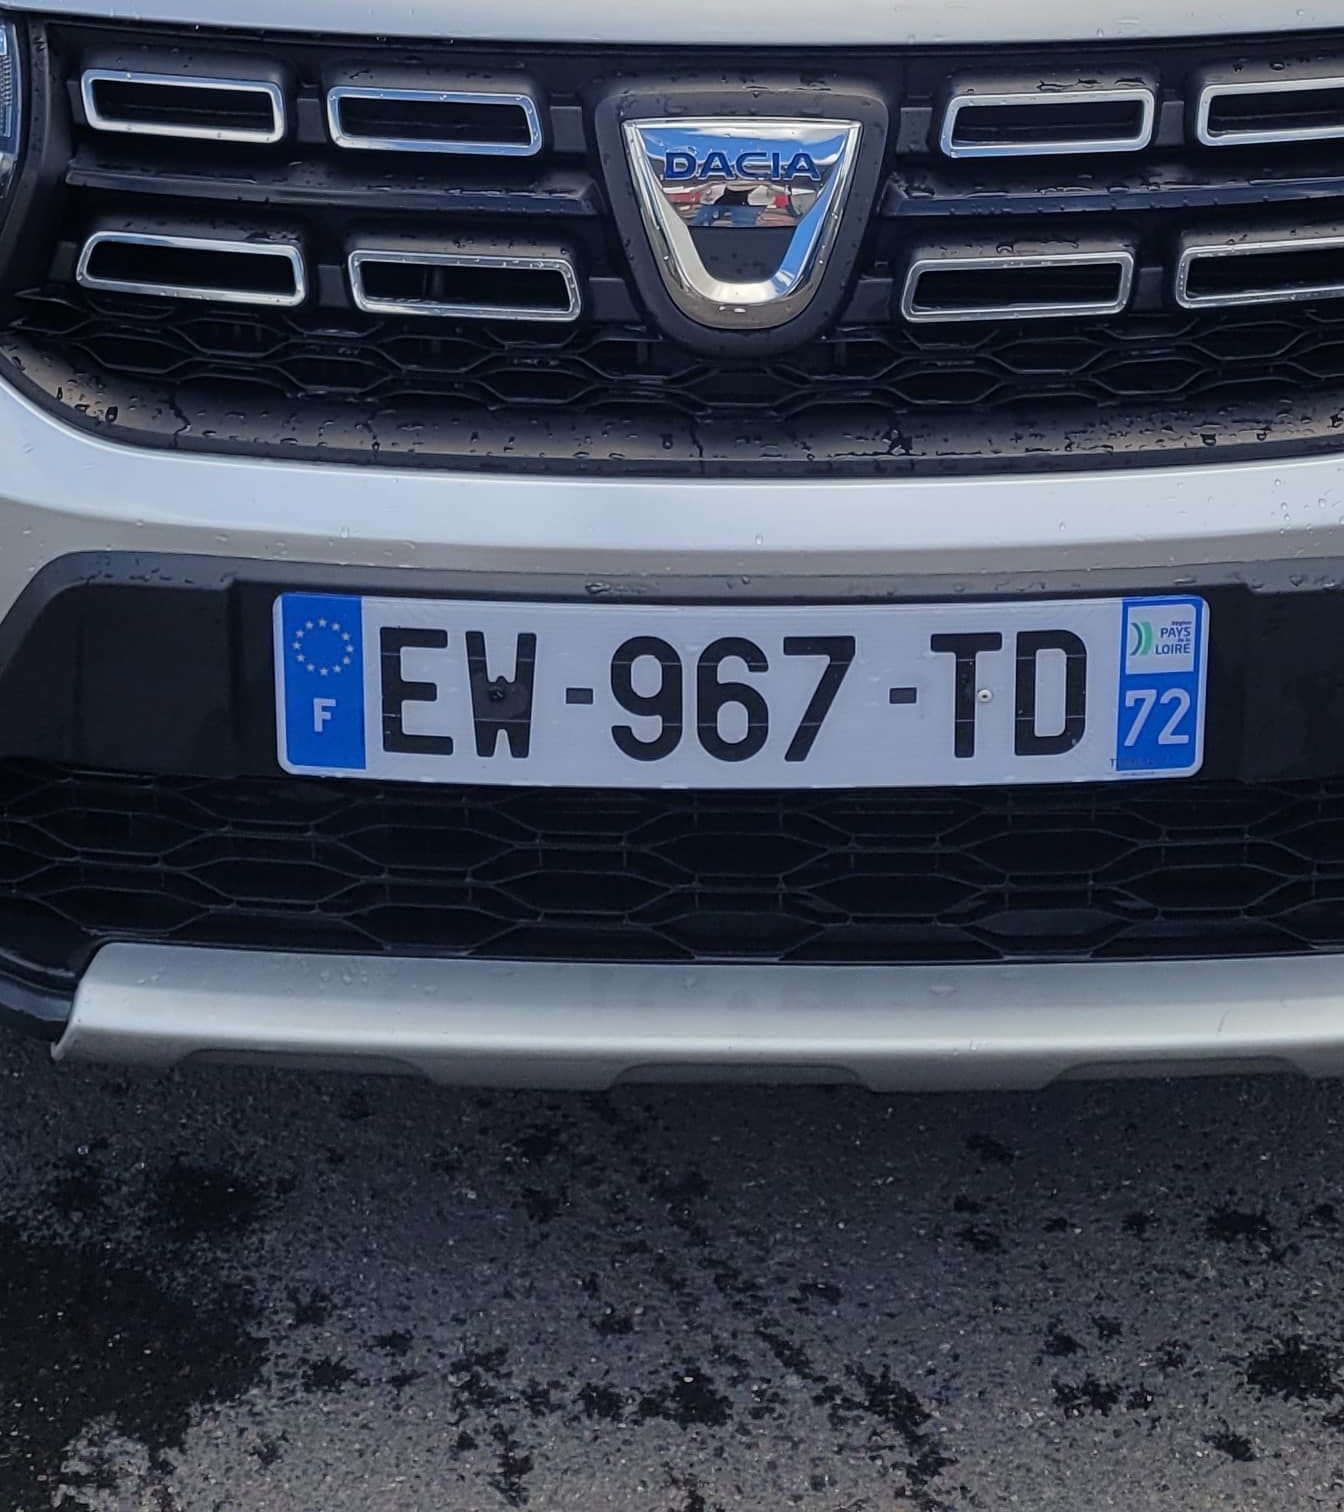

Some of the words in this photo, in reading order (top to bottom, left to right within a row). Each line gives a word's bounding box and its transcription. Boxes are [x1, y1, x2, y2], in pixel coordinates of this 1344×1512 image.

[664, 151, 822, 181] DACIA
[1160, 626, 1191, 638] PAYS
[1155, 642, 1191, 655] LOIRE
[313, 697, 337, 733] F
[1124, 688, 1191, 747] 72
